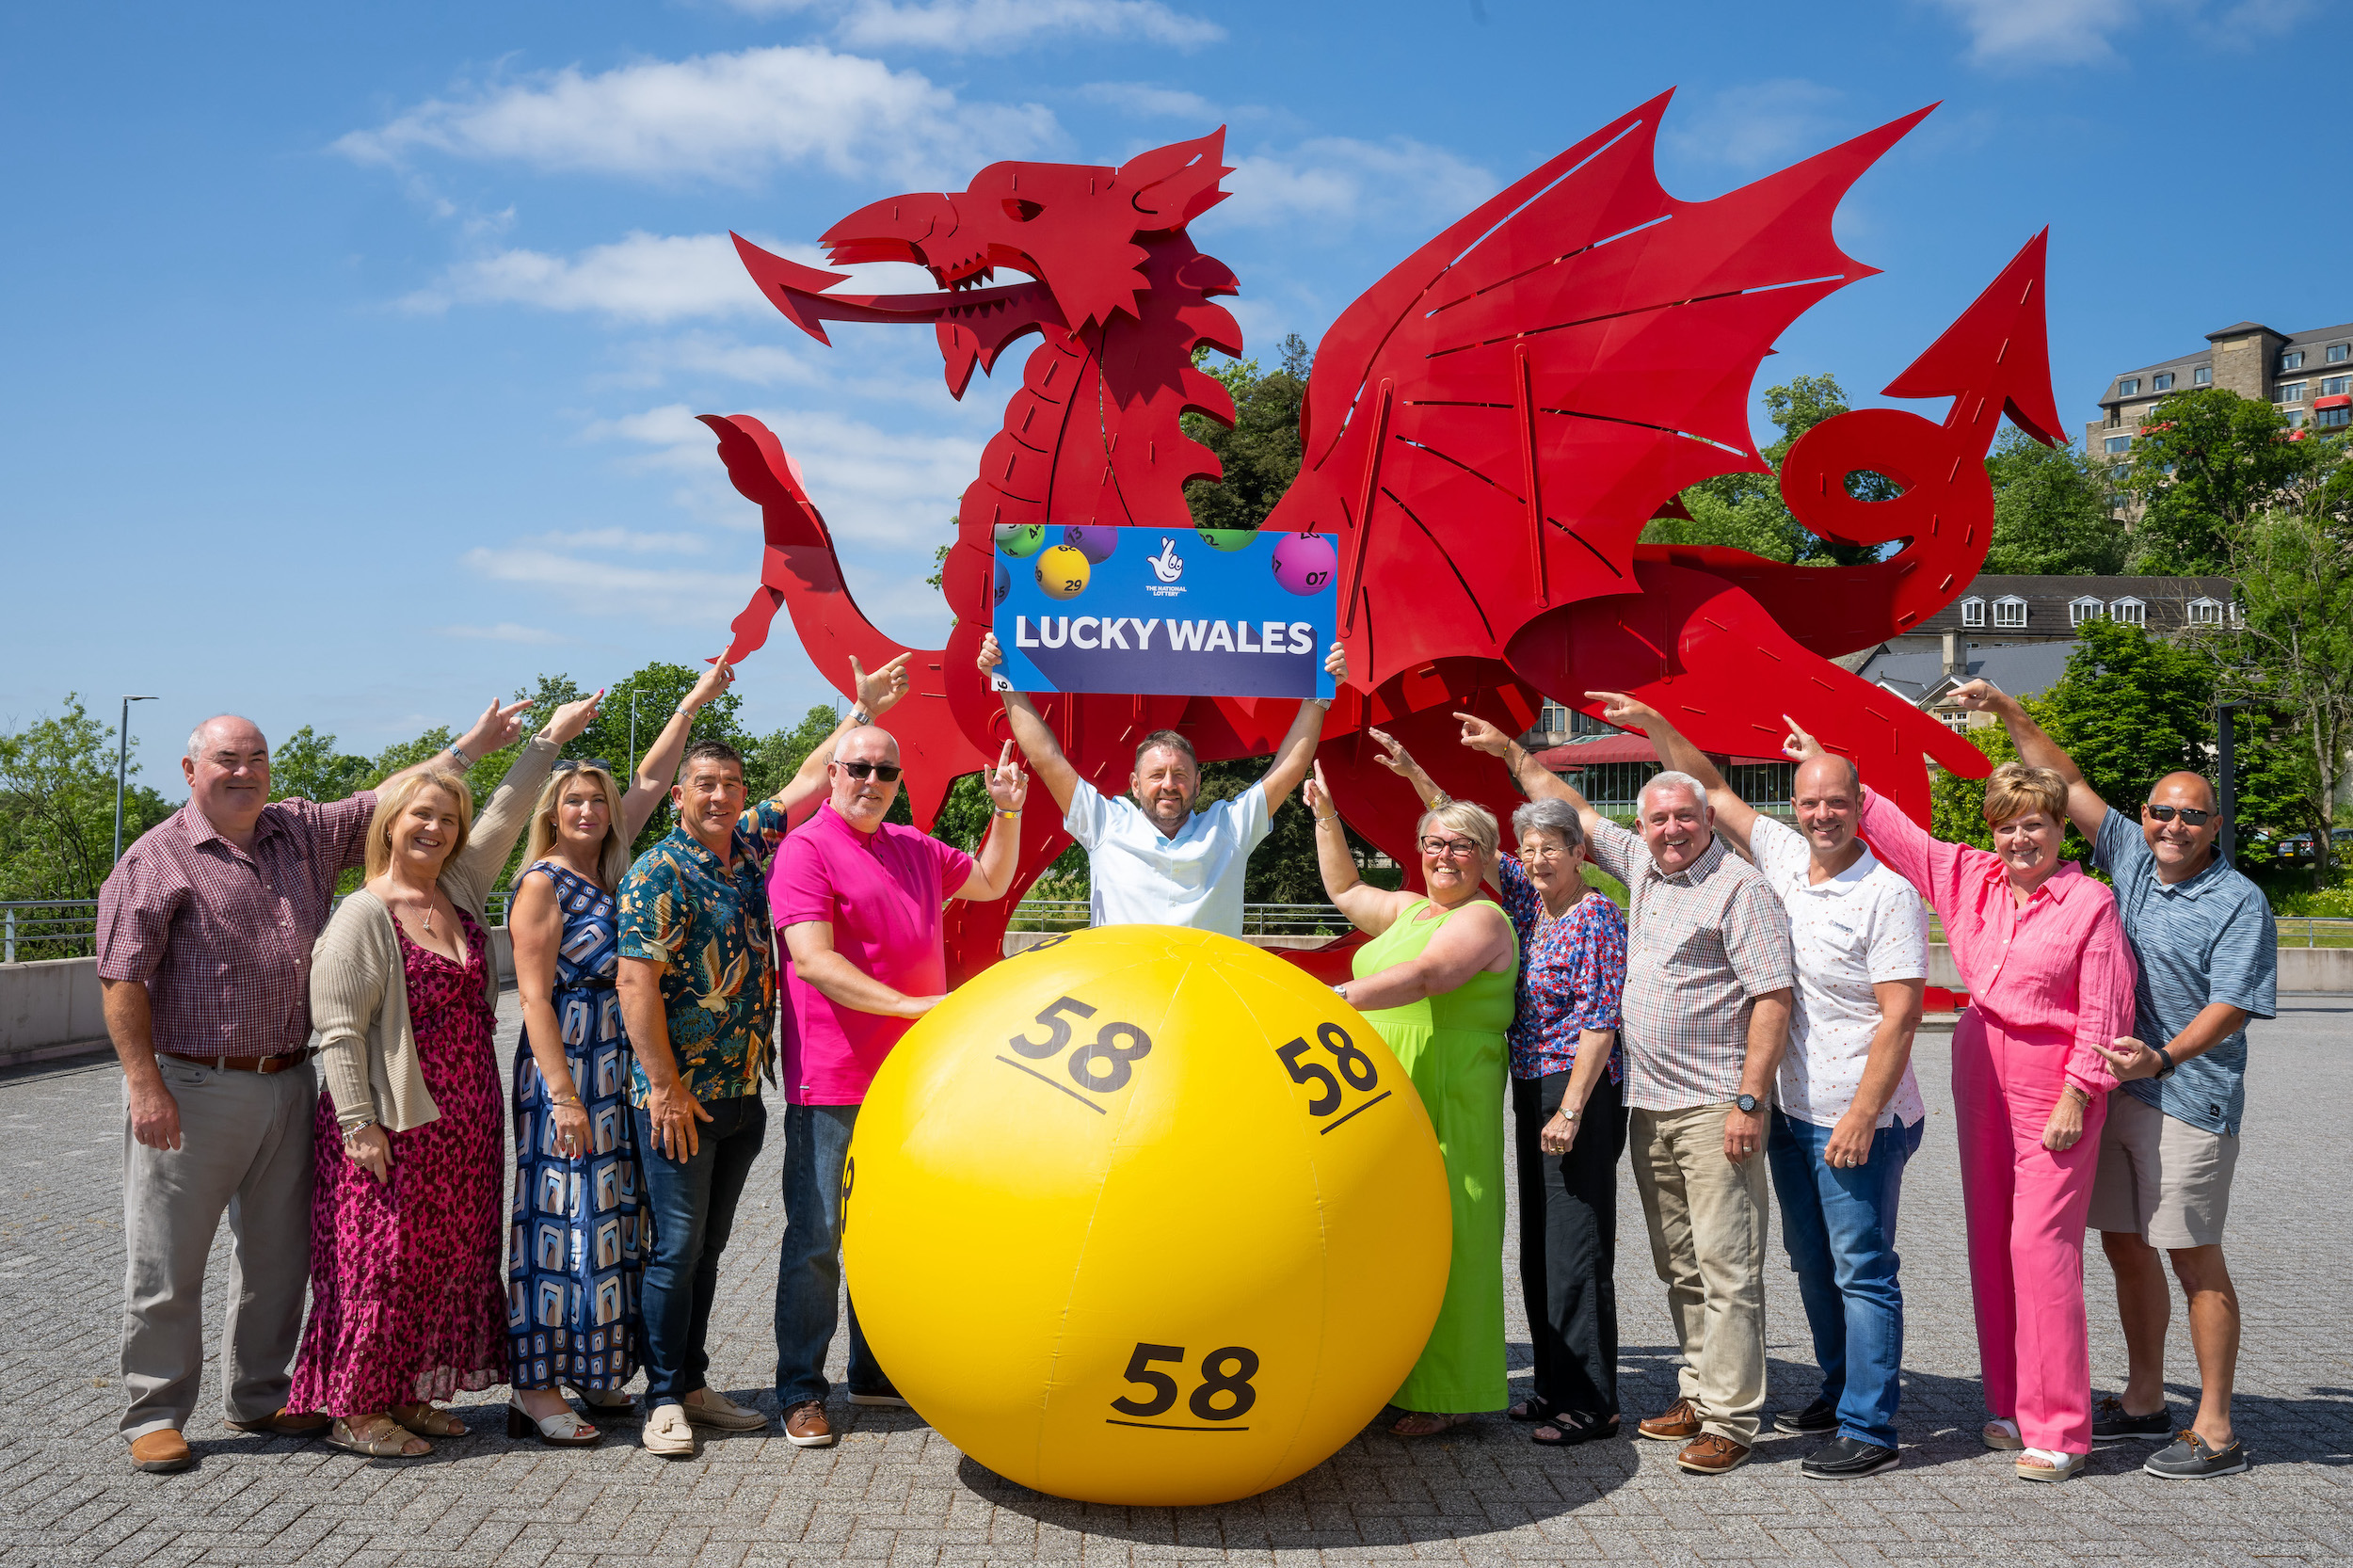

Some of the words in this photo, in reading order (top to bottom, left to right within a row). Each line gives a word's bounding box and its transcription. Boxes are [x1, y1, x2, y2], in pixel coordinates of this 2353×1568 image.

[1067, 526, 1082, 543] 13
[1003, 548, 1018, 557] 4
[1064, 579, 1082, 592] 29
[1305, 571, 1328, 585] 07
[1016, 616, 1160, 650] LUCKY
[1166, 618, 1313, 655] WALES
[1009, 995, 1152, 1093] 58
[1275, 1022, 1378, 1117] 58
[1110, 1342, 1259, 1421] 58
